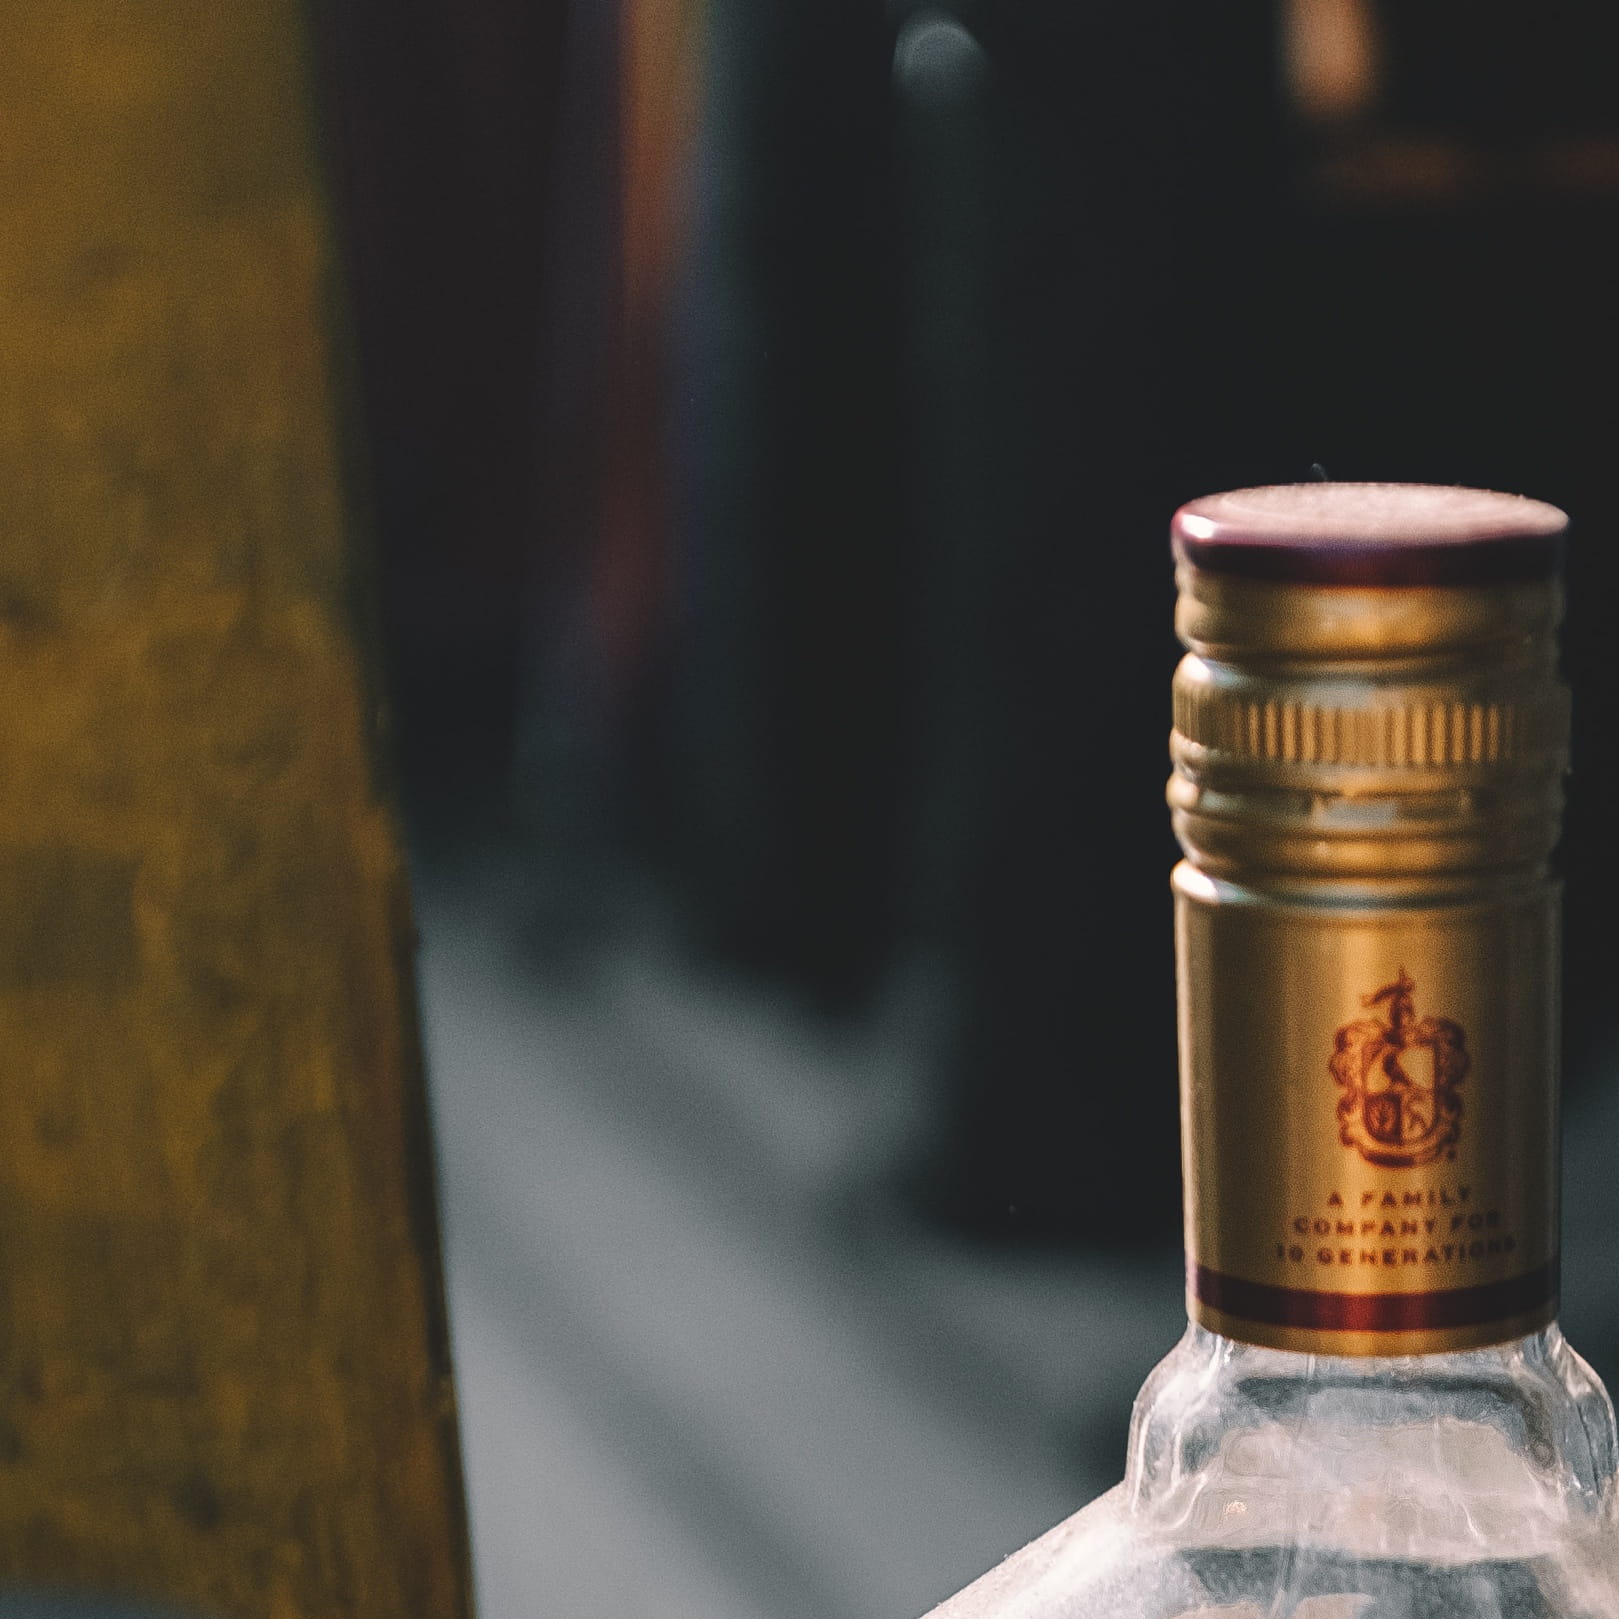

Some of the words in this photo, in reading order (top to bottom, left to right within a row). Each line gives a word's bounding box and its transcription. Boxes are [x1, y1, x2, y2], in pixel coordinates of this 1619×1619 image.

[1327, 1190, 1343, 1207] A
[1361, 1185, 1472, 1208] FAMILY
[1293, 1214, 1437, 1236] COMPANY
[1451, 1209, 1501, 1231] FOR
[1315, 1235, 1517, 1266] GENERATIONS
